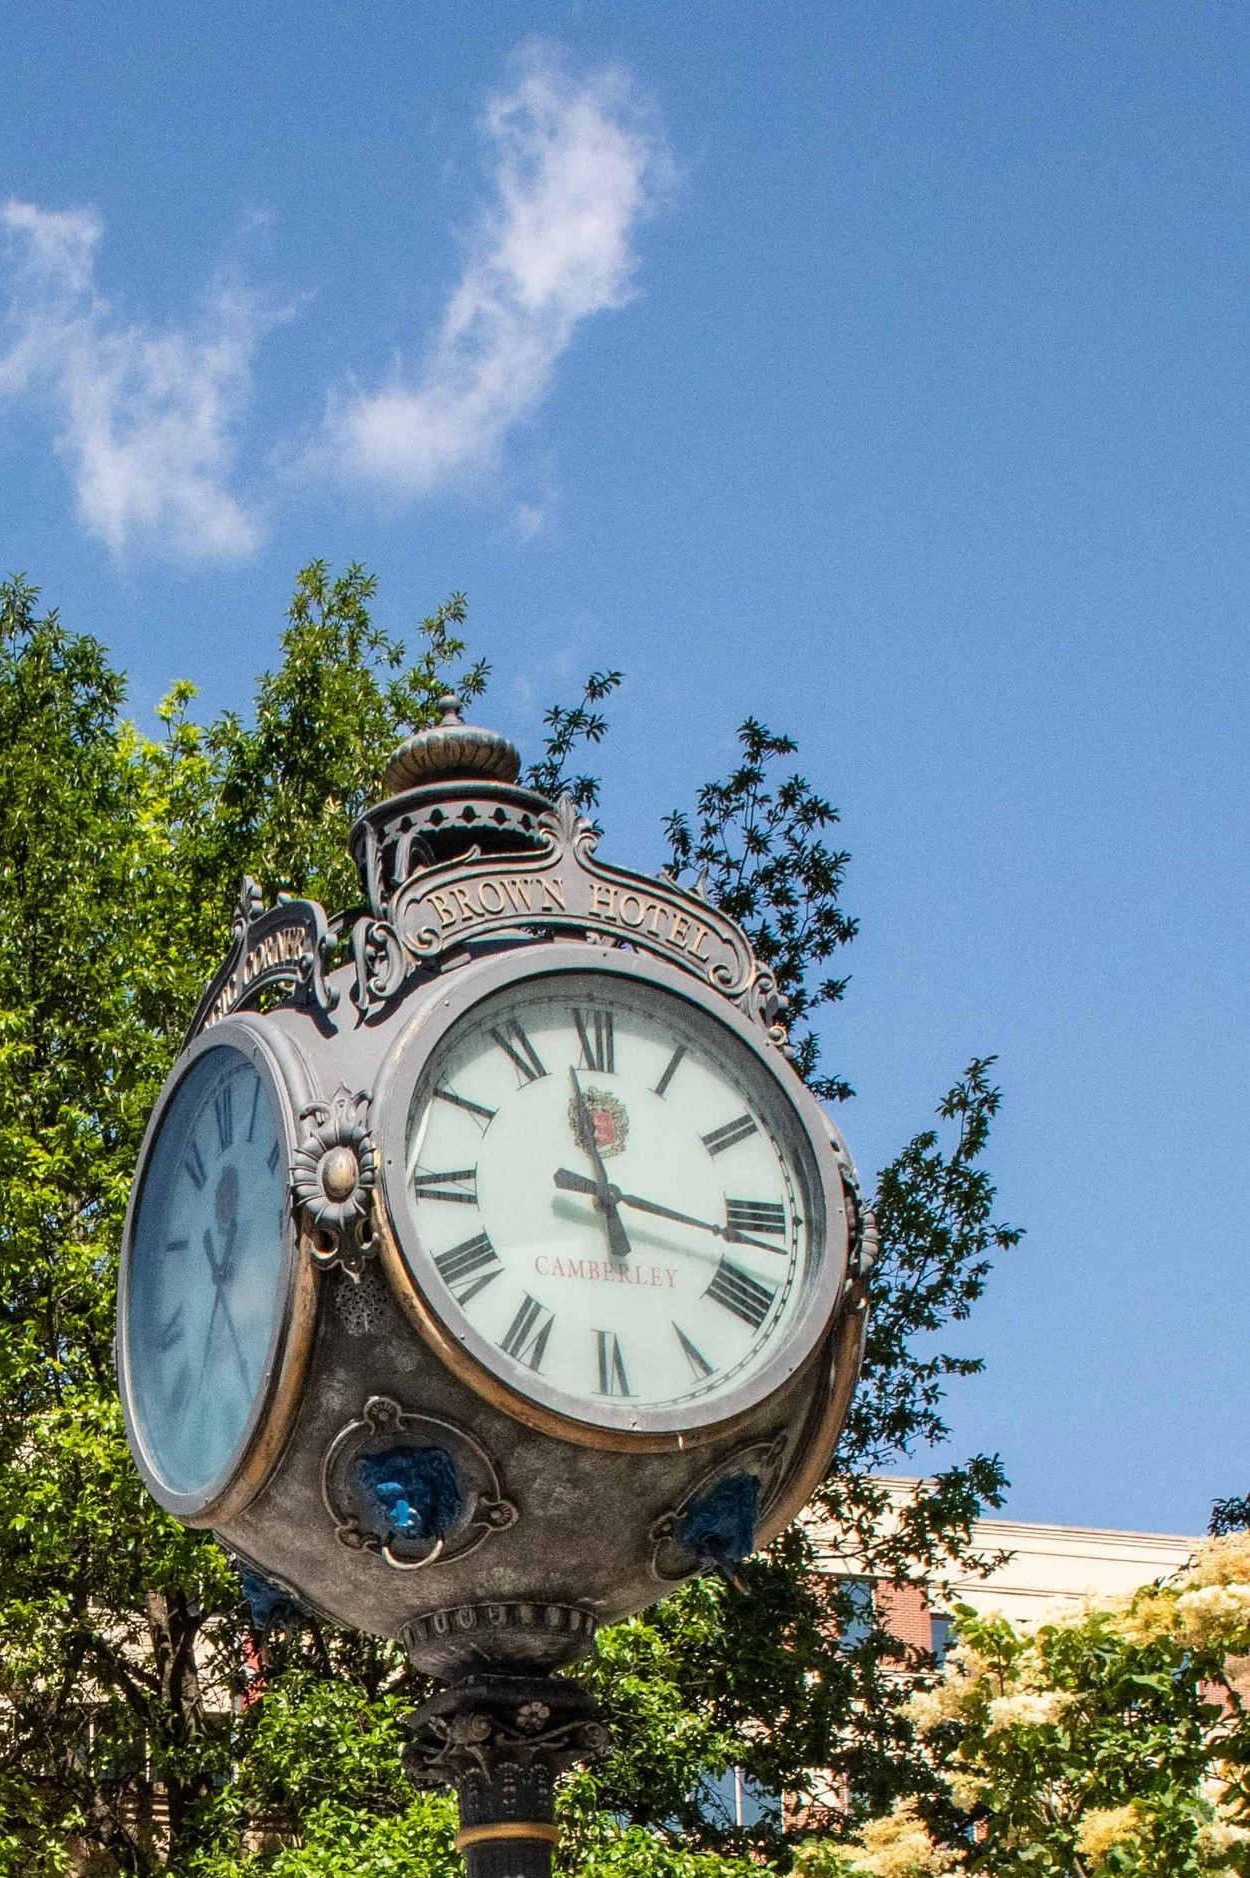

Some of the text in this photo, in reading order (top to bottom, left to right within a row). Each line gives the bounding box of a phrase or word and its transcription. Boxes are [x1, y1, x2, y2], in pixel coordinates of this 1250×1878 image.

[427, 876, 710, 962] BROWN HOTEL
[566, 1007, 619, 1075] XII
[697, 1106, 762, 1163] II
[534, 1255, 678, 1288] CAMBERLEY
